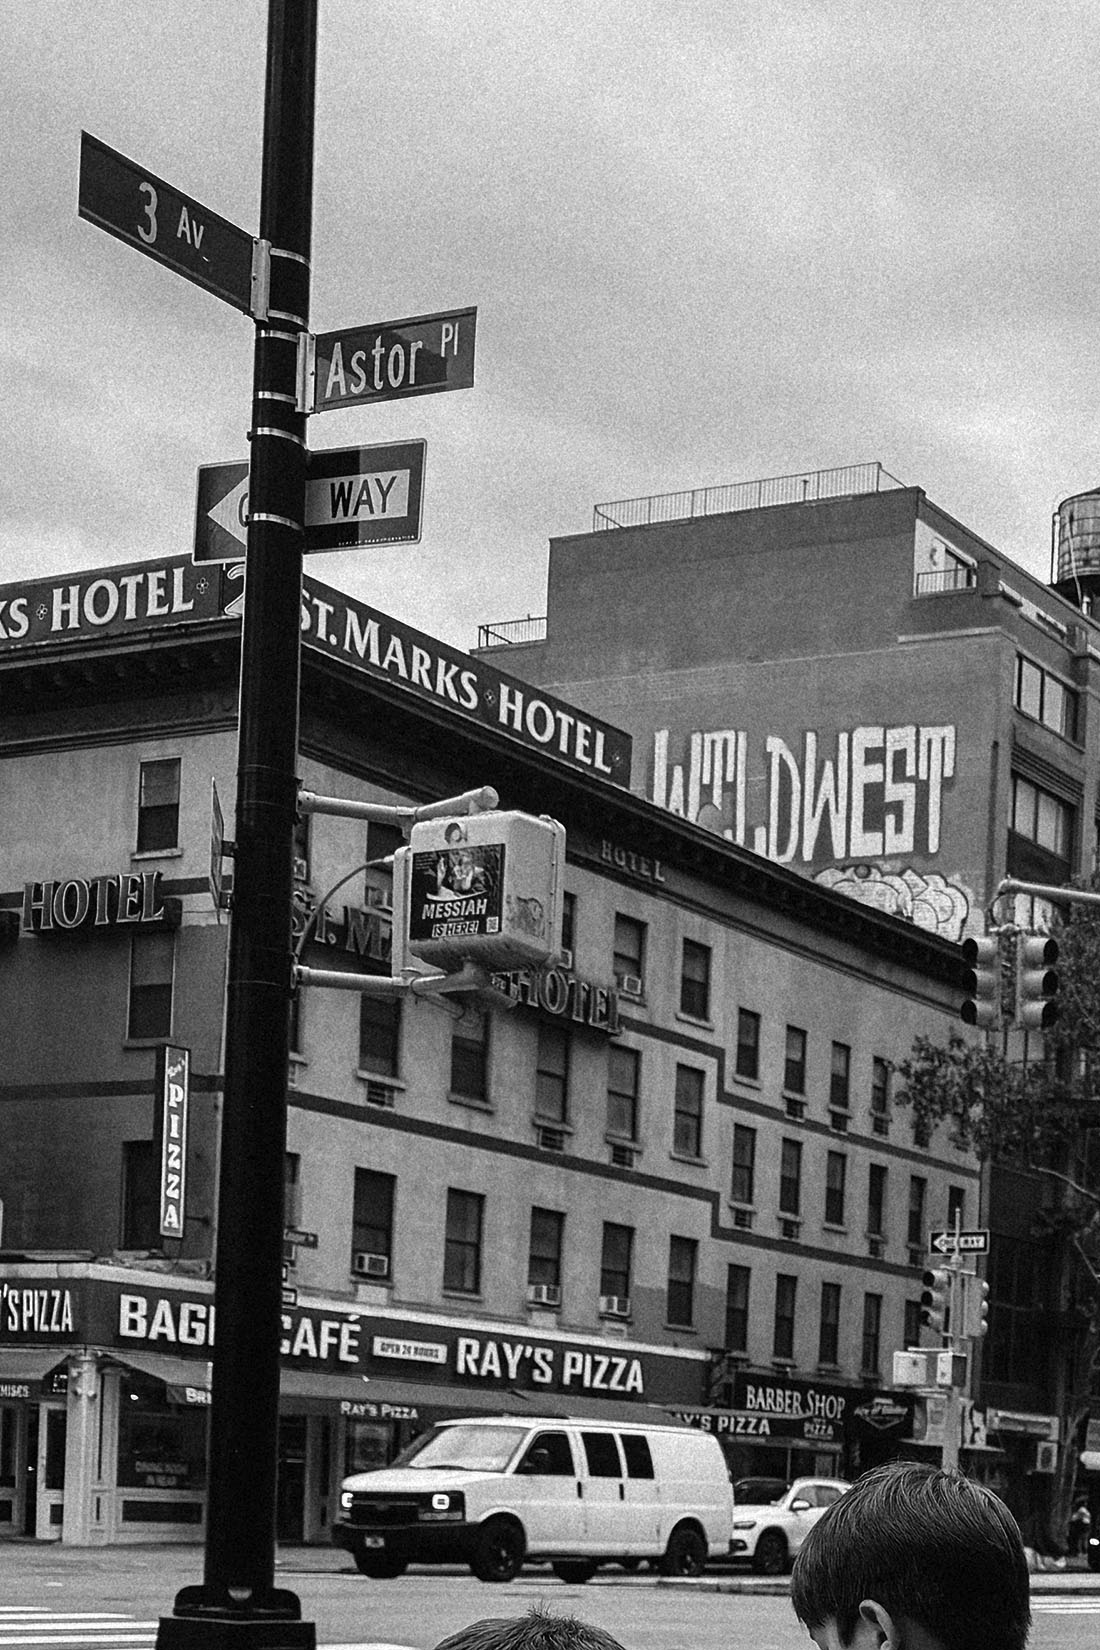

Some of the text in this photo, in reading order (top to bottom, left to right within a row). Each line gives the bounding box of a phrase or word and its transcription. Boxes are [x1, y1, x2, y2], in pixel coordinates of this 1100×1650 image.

[136, 181, 205, 250] 3 Av
[325, 321, 460, 400] Astor Pl
[329, 475, 398, 519] WAY
[50, 566, 195, 632] HOTEL
[342, 607, 479, 711] MARKS
[498, 682, 613, 775] HOTEL
[22, 871, 166, 932] HOTEL
[421, 898, 488, 920] MESSIAH
[433, 920, 479, 937] IS HERE!
[163, 1082, 185, 1230] PIZZA
[0, 1283, 74, 1333] 'S PIZZA
[456, 1337, 645, 1395] RAY'S PIZZA
[0, 1384, 30, 1399] MISES
[381, 1403, 419, 1420] PIZZA
[746, 1384, 803, 1416] BARBER
[806, 1389, 846, 1420] SHOP
[717, 1415, 771, 1436] PIZZA
